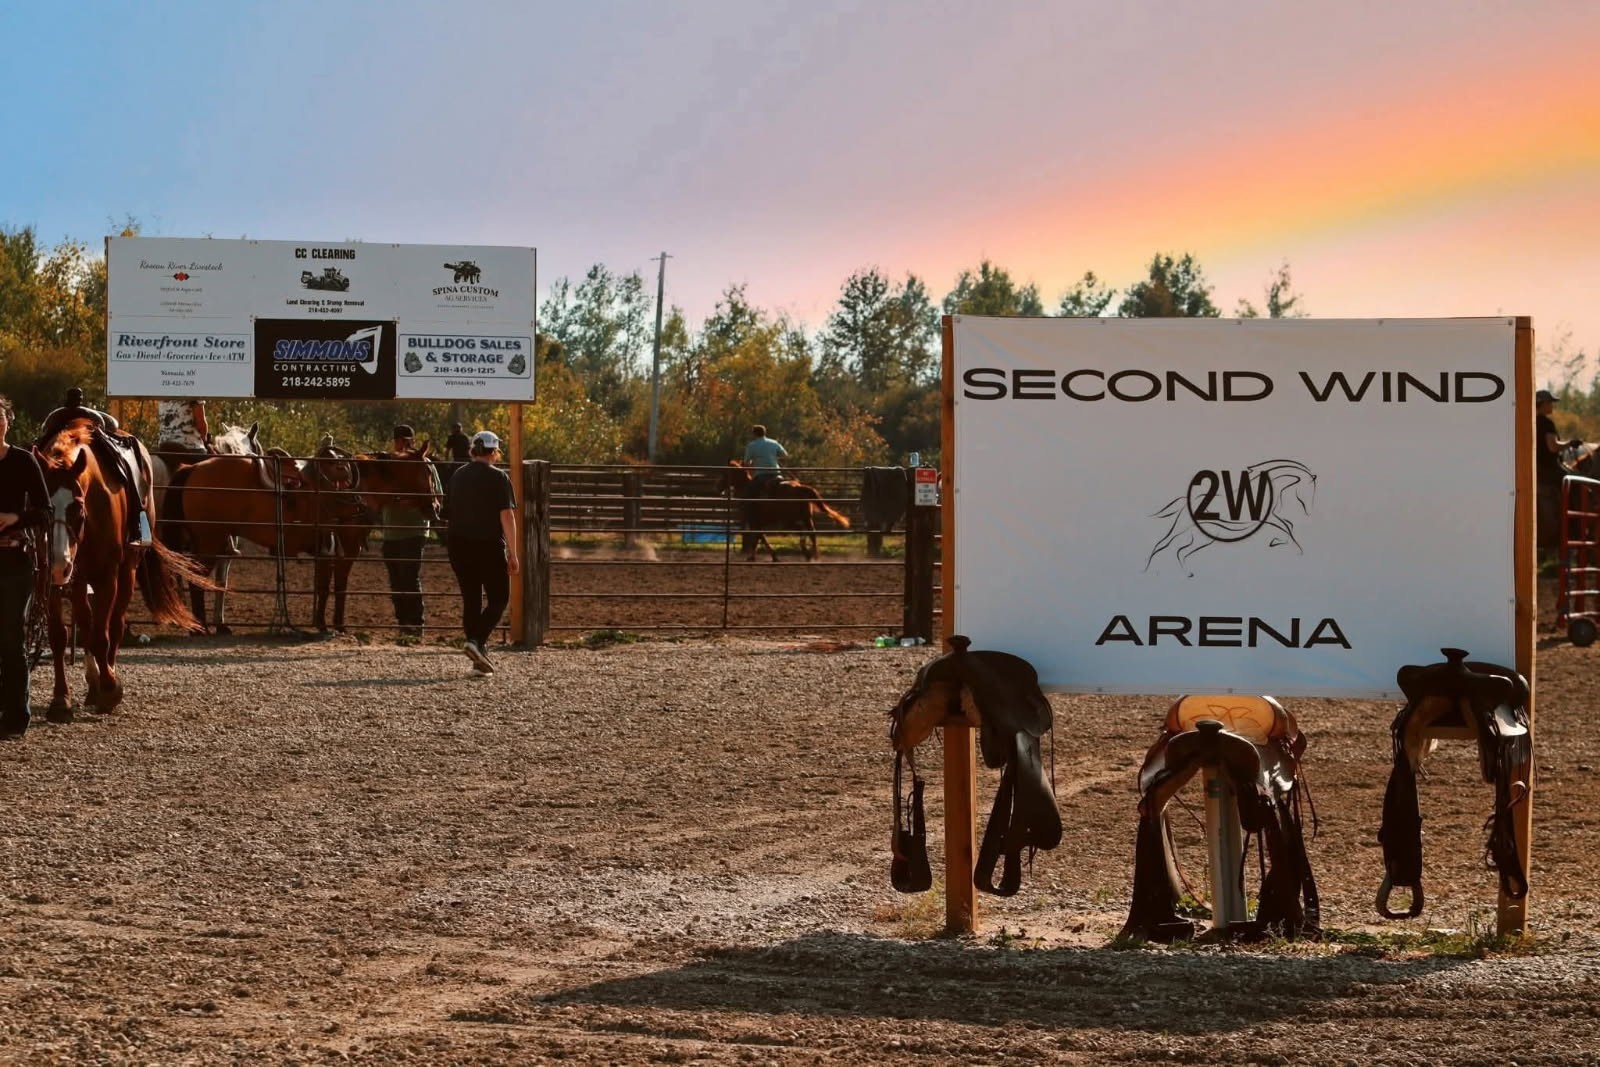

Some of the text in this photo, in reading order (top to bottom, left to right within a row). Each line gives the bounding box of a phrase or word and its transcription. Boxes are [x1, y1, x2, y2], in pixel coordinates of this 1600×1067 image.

[295, 248, 355, 260] CC CLEARING
[167, 261, 187, 271] River
[432, 285, 499, 298] SPINA CUSTOM
[117, 334, 245, 350] Riverfront Store
[407, 337, 476, 349] BULLDOG
[116, 350, 245, 361] Gas Diesel Groceries Ice ATM
[273, 339, 371, 361] SIMMONS
[425, 351, 438, 363] &
[273, 363, 357, 372] CONTRACTING
[281, 377, 351, 387] 218-242-5895
[963, 368, 1506, 404] SECOND WIND
[1190, 470, 1268, 521] 2W
[1096, 615, 1352, 650] ARENA
